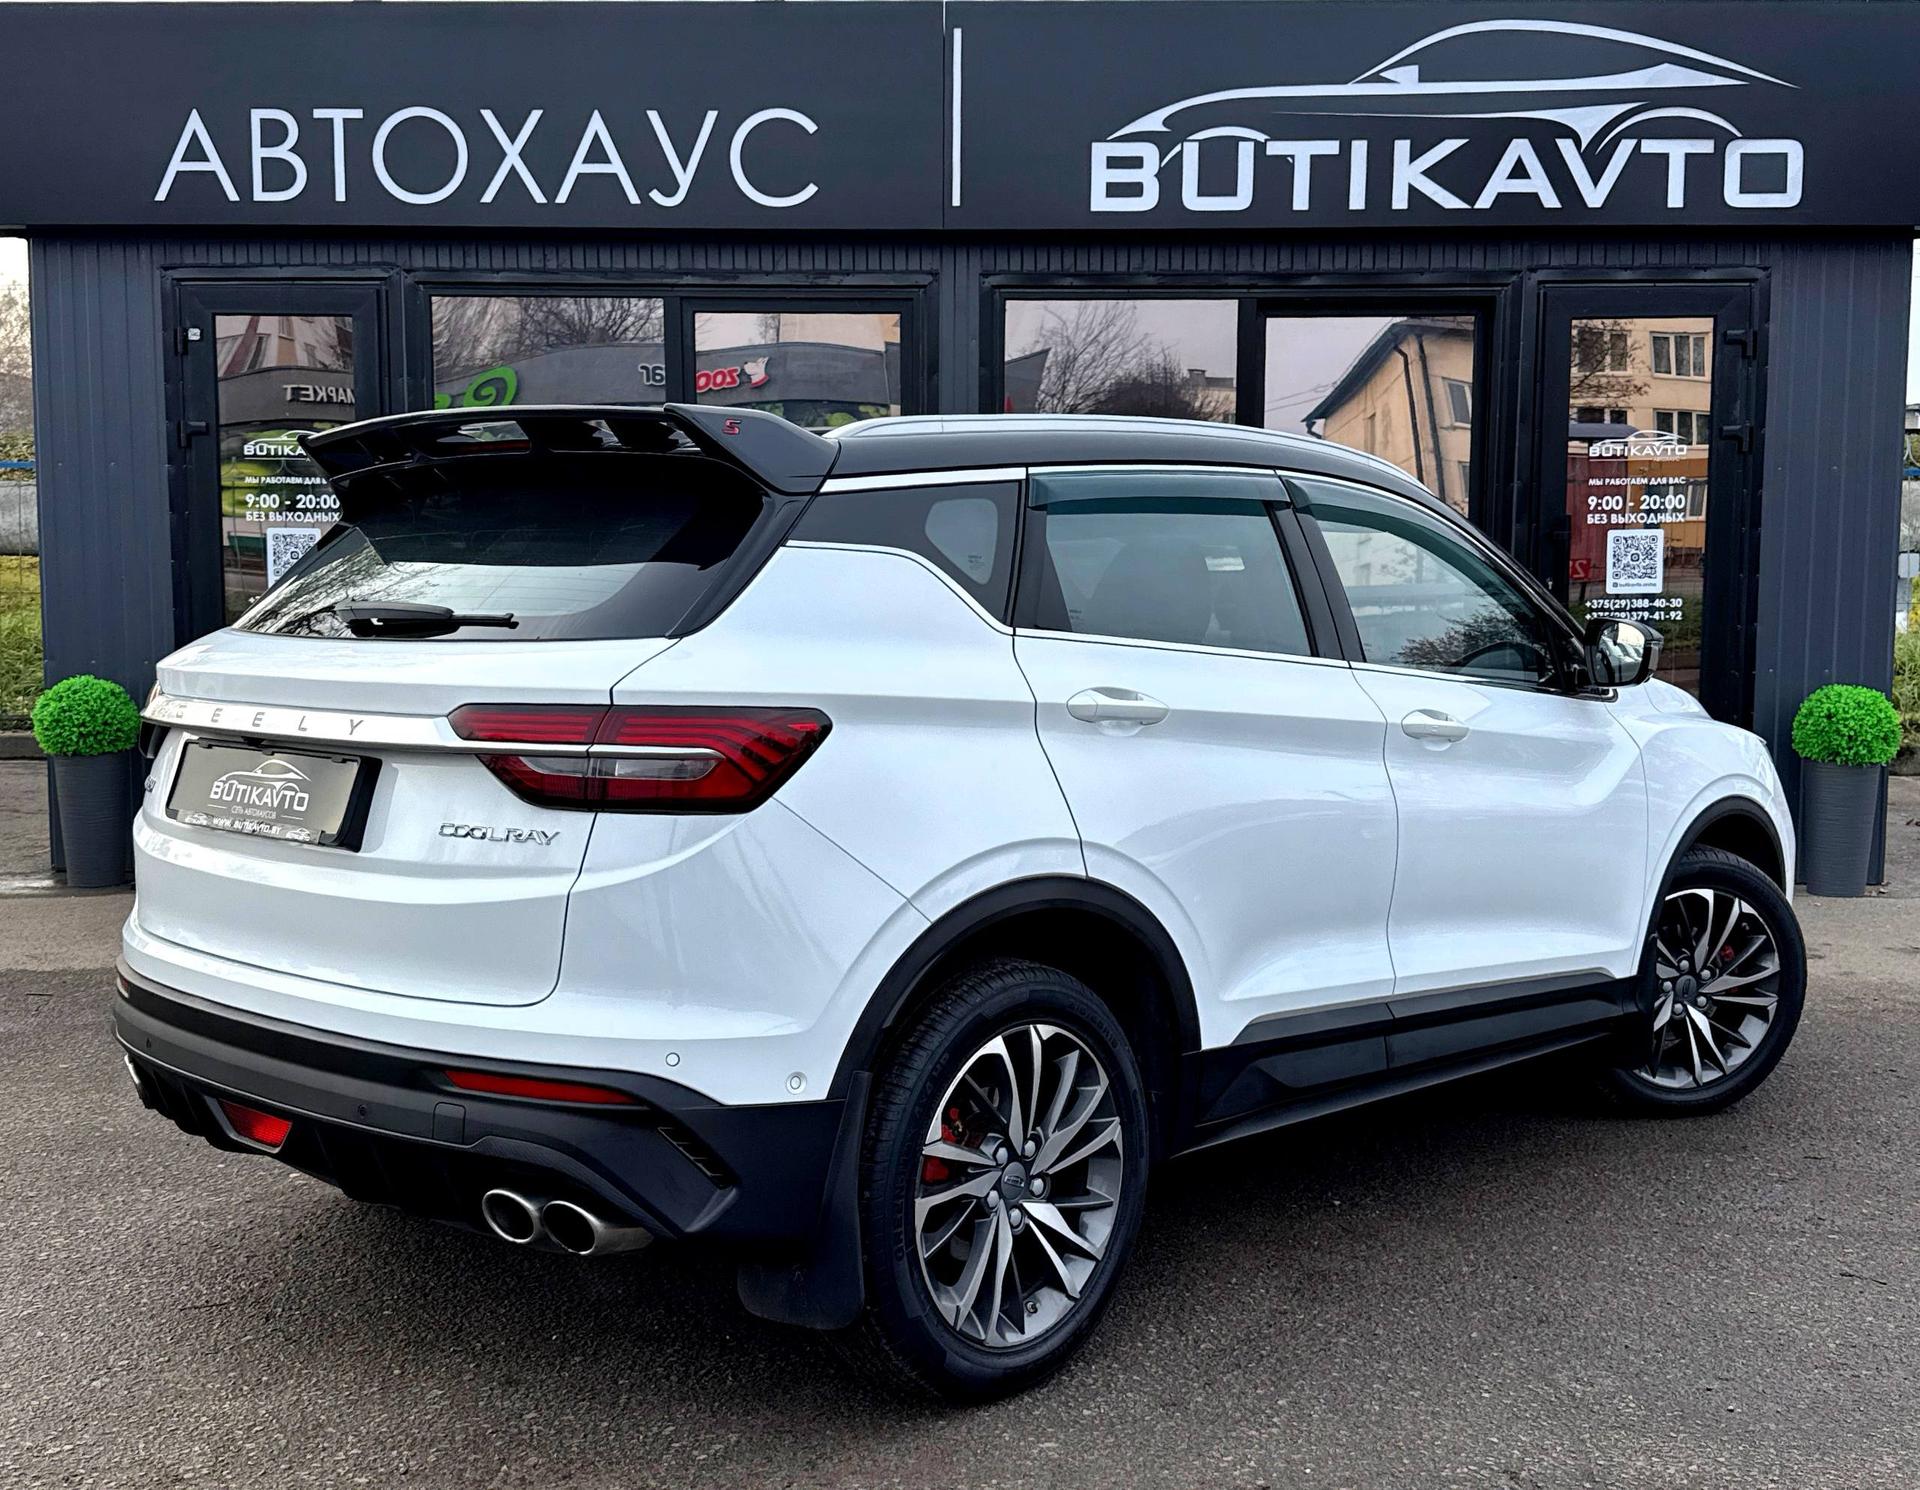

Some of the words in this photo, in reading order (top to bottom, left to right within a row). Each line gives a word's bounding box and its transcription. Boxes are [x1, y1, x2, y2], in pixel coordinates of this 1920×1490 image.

[154, 107, 819, 208] АВТОХАУС
[1090, 137, 1803, 212] BUTIKAVTO
[243, 444, 307, 456] BUTIKA
[1589, 445, 1687, 457] BUTIKAVTO
[244, 476, 259, 484] МЫ
[261, 476, 304, 484] РАБОТАЕМ
[304, 476, 320, 485] ДЛЯ
[1588, 478, 1603, 486] МЫ
[1605, 477, 1648, 486] РАБОТАЕМ
[1649, 477, 1666, 486] ДЛЯ
[1668, 476, 1686, 485] ВАС
[245, 493, 280, 509] 9:00
[296, 493, 340, 509] 20:00
[1587, 495, 1623, 511] 9:00
[1640, 494, 1686, 510] 20:00
[245, 511, 266, 522] БЕЗ
[268, 511, 340, 523] ВЫХОДНЫХ
[1586, 513, 1607, 525] БЕЗ
[1610, 512, 1685, 524] ВЫХОДНЫХ
[1585, 598, 1682, 610] +375(29)388-40-30
[209, 780, 310, 812] BUTIKAVTO
[438, 823, 560, 845] COOLRAY
